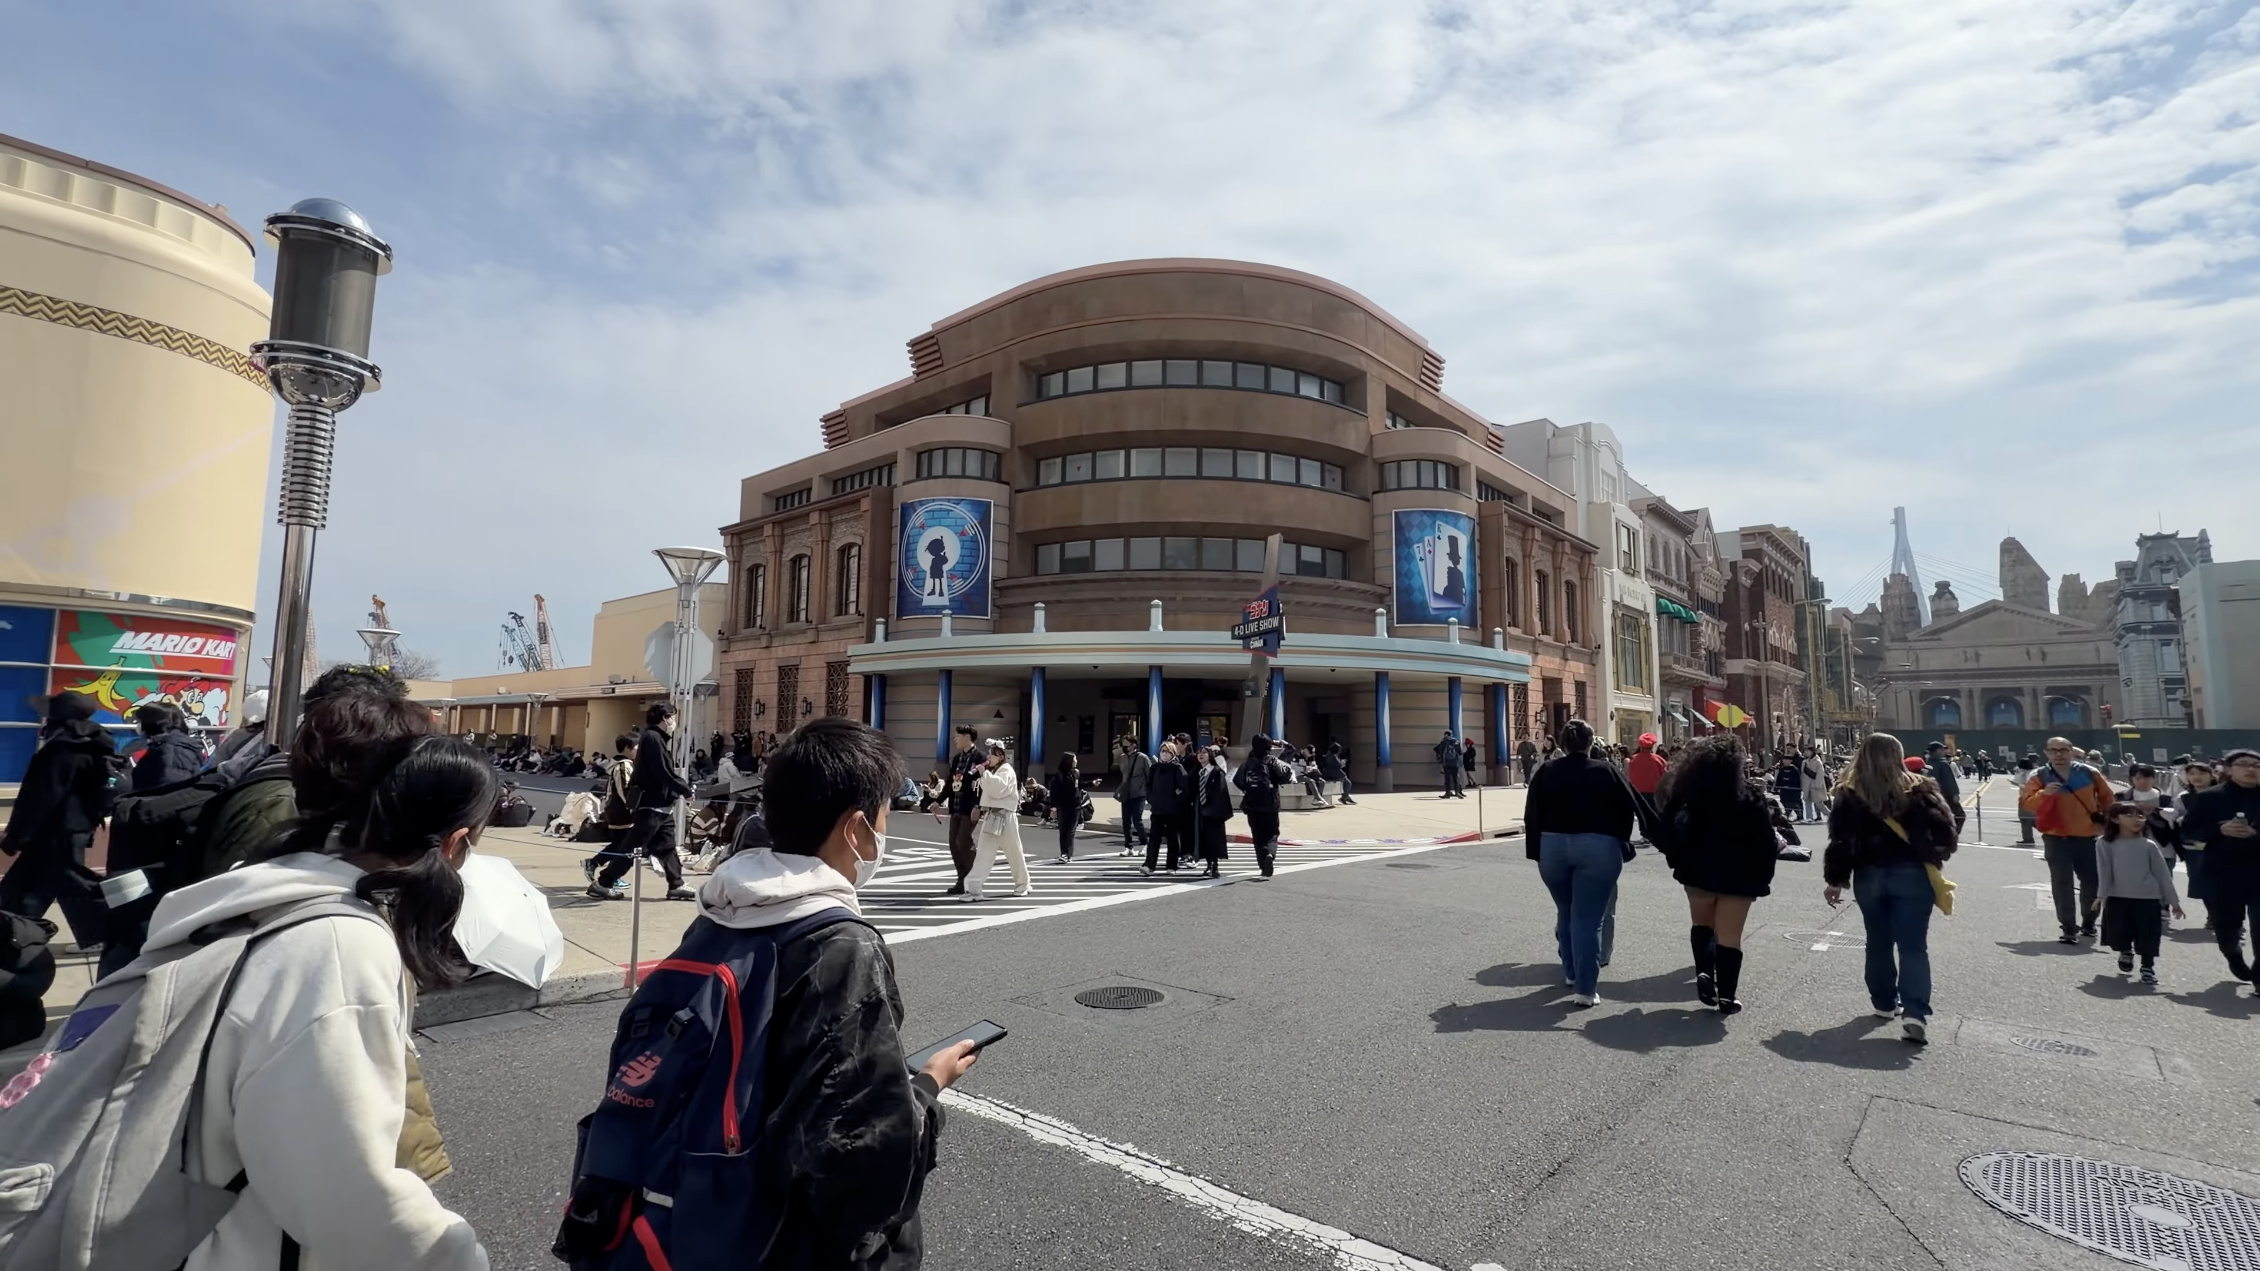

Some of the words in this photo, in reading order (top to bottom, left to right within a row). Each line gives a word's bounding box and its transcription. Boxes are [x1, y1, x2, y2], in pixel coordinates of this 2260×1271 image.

[1234, 625, 1244, 636] 4-D
[1245, 621, 1258, 634] LIVE
[1259, 616, 1279, 631] SHOW
[113, 631, 203, 654] MARIO
[203, 639, 236, 658] KART
[607, 1084, 654, 1107] balance
